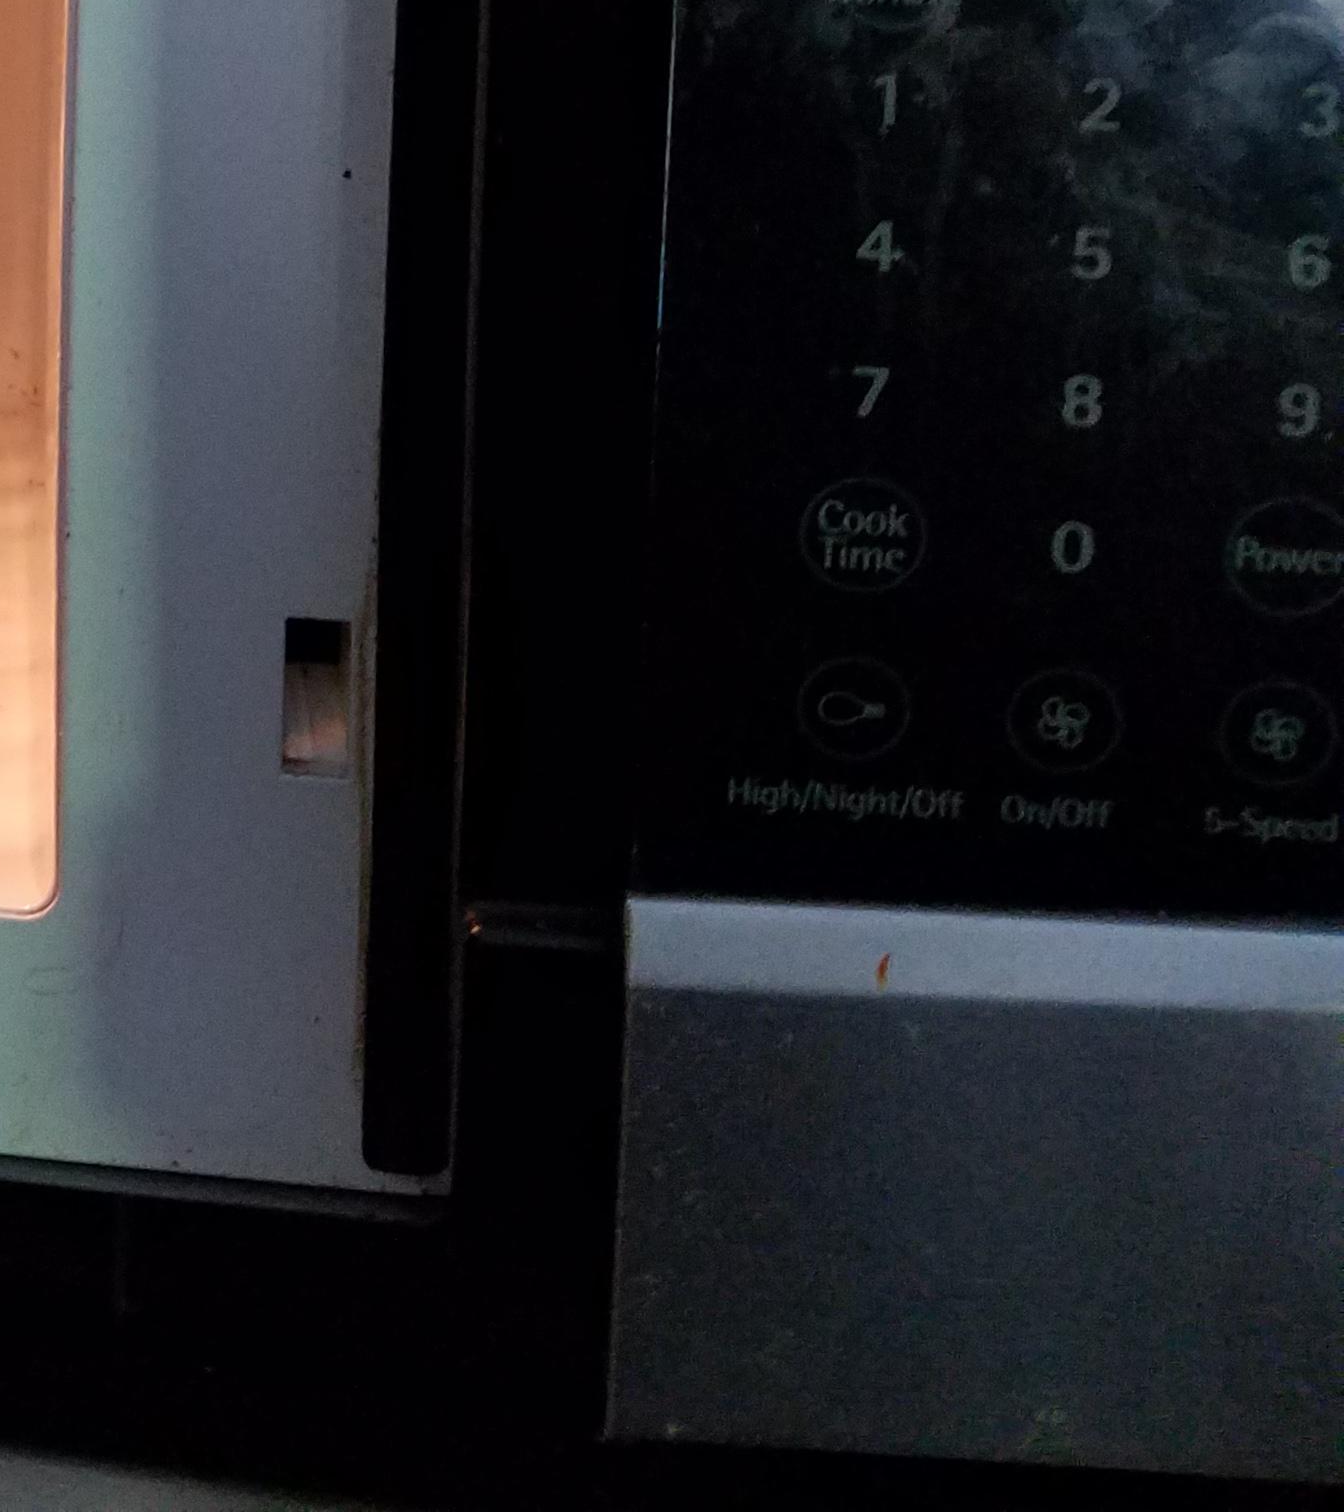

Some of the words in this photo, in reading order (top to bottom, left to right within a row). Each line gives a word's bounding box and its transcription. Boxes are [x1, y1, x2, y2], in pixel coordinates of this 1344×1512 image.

[873, 74, 897, 134] 1
[1078, 78, 1121, 133] 2
[1299, 82, 1340, 138] 3
[855, 219, 905, 273] 4
[1071, 227, 1112, 280] 5
[1287, 235, 1332, 287] 6
[851, 366, 890, 418] 7
[1063, 373, 1104, 428] 8
[1278, 382, 1322, 438] 9
[816, 499, 911, 539] Cook
[819, 536, 906, 575] Time
[1050, 520, 1095, 575] 0
[726, 775, 967, 823] High/Night/Off
[999, 793, 1116, 832] On/Off
